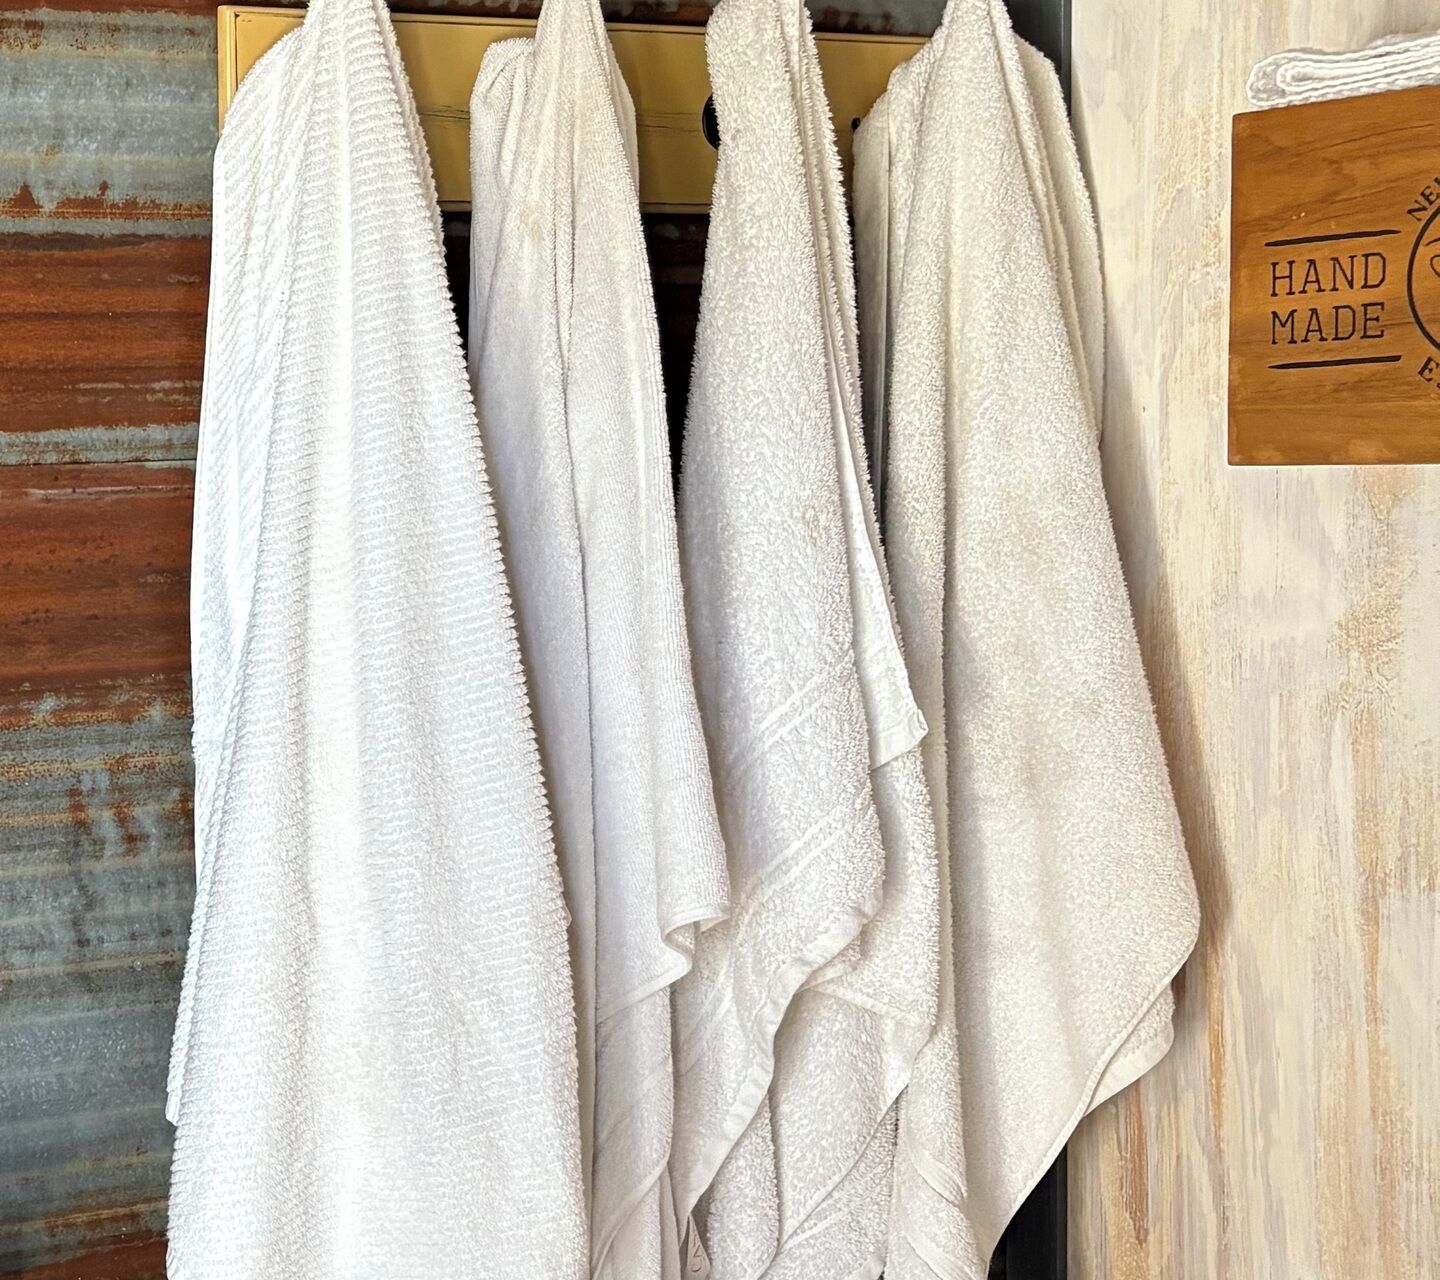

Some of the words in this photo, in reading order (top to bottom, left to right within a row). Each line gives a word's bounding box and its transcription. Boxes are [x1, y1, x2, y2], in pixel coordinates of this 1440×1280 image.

[1407, 177, 1440, 221] NE
[1270, 252, 1386, 297] HAND
[1271, 301, 1385, 345] MADE
